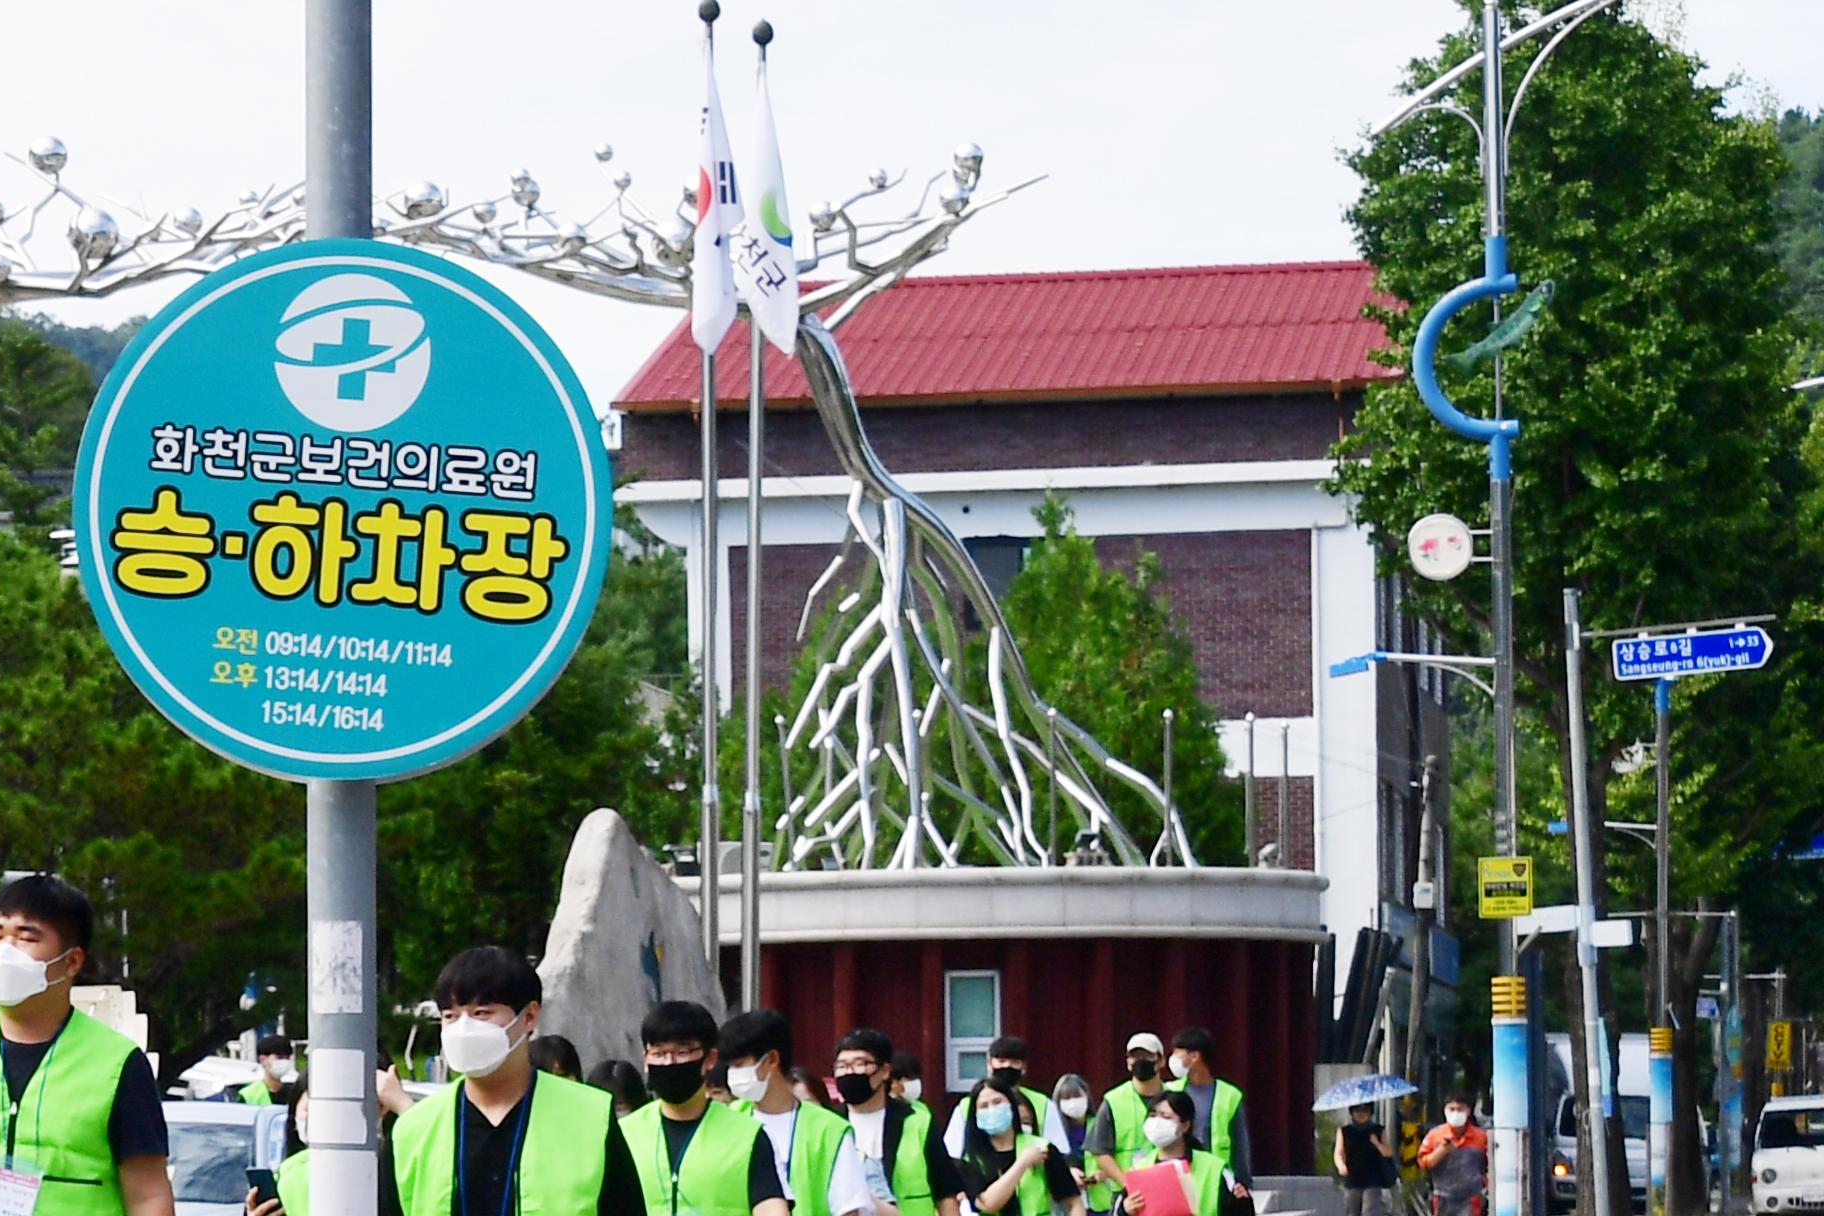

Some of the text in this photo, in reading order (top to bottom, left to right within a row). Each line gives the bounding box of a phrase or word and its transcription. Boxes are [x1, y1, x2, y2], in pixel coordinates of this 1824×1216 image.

[150, 422, 539, 500] 화천군보건의료원
[111, 486, 571, 626] 승·하차장
[212, 626, 453, 667] 오전 09:14/10:14/11:14
[1620, 652, 1750, 675] Sangseung-ro 6(yuk)-gil
[209, 661, 388, 697] 오후 13:14/14:14
[262, 700, 385, 732] 15:14/16:14
